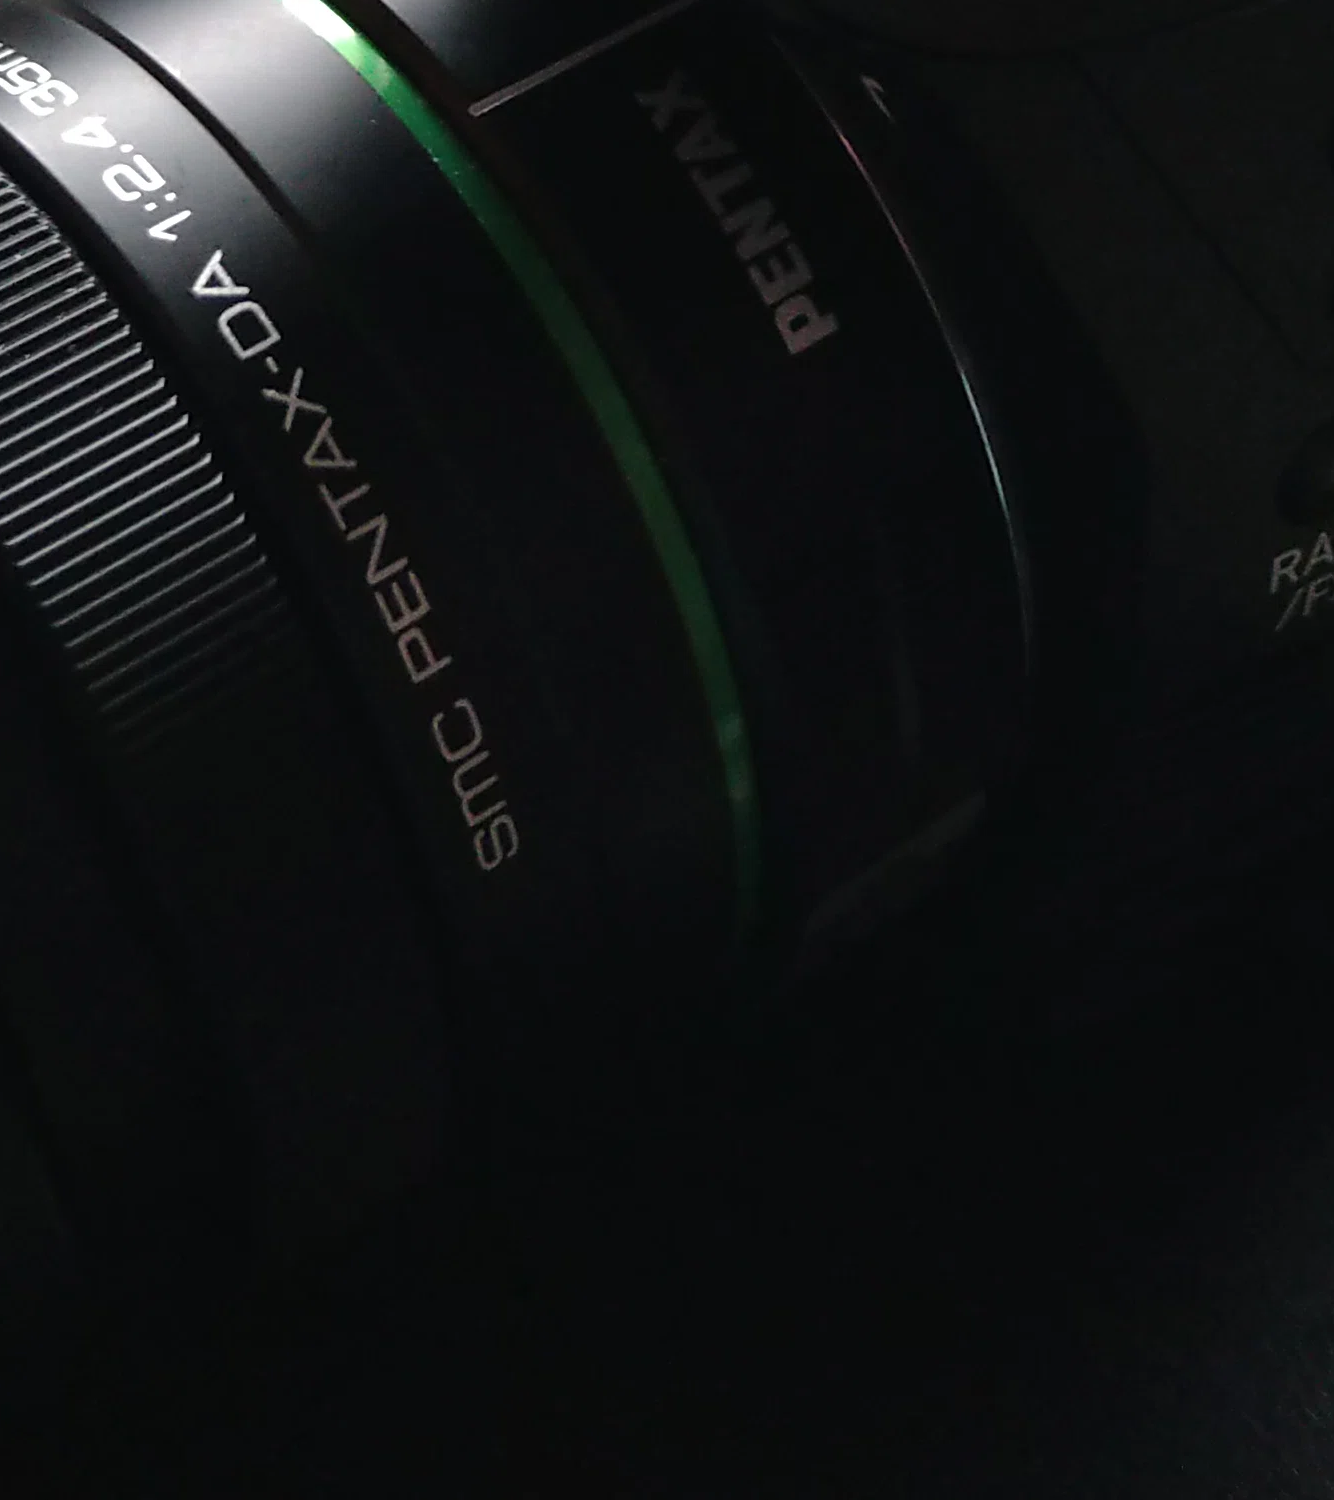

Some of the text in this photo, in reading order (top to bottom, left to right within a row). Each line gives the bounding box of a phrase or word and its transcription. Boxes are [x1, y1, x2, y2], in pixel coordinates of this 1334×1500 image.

[61, 114, 194, 244] 1:2.4
[634, 71, 840, 355] PENTAX
[192, 250, 452, 684] PENTAX-DA
